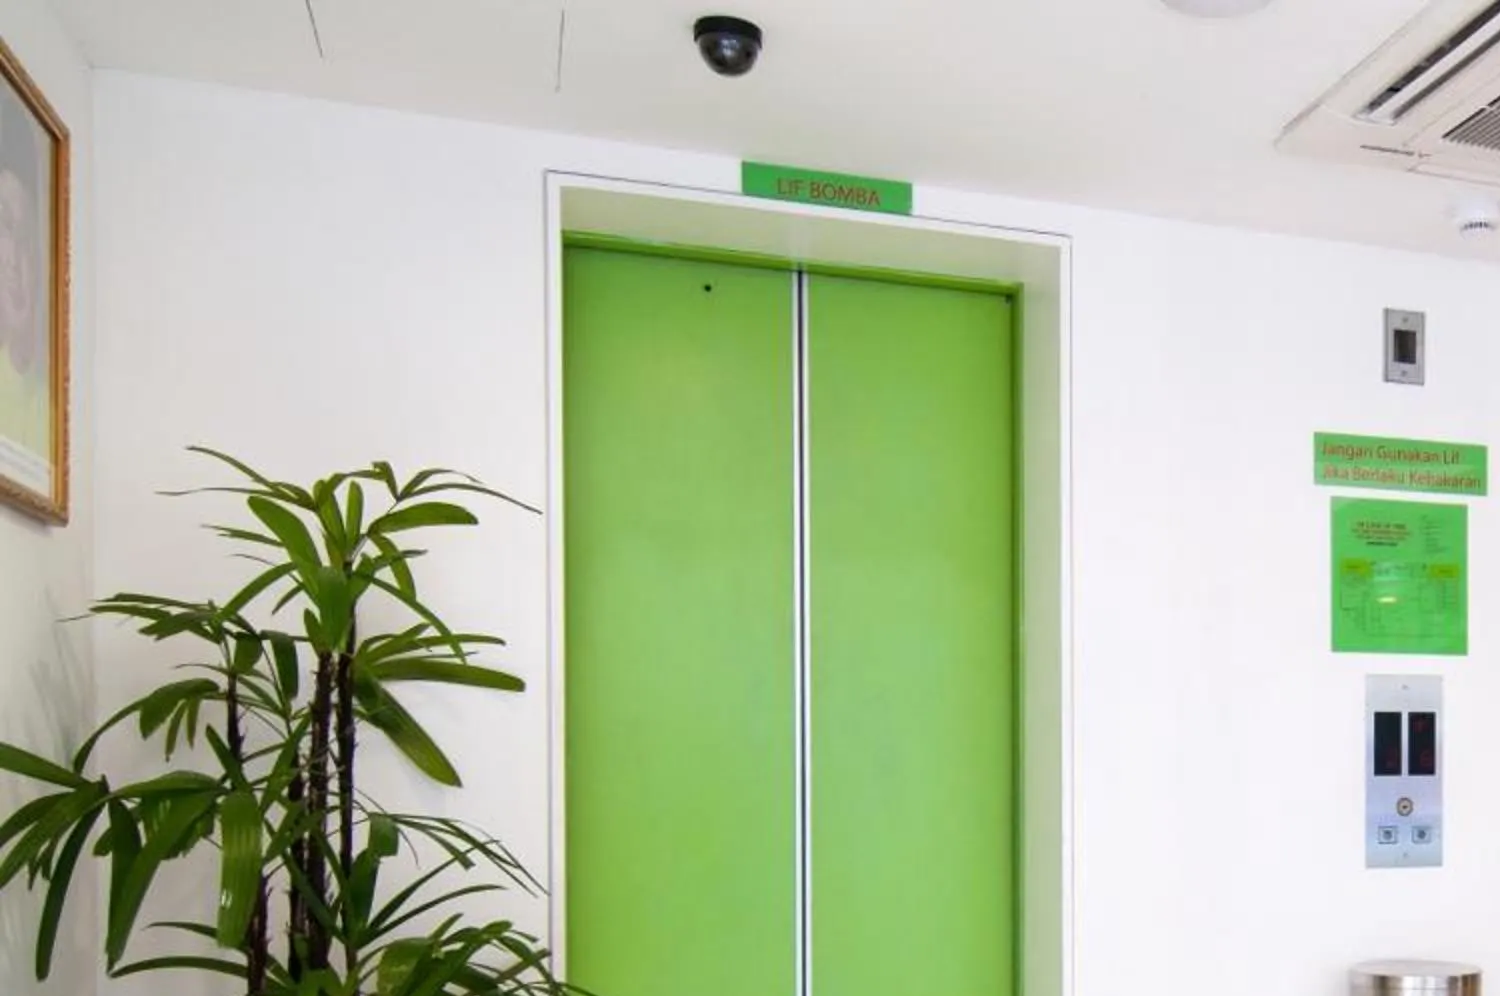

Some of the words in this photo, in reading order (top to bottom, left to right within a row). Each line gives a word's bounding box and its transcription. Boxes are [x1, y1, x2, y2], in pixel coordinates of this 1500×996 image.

[776, 178, 805, 196] LIF
[809, 181, 880, 206] BOMBA
[1322, 442, 1373, 461] Jangan
[1377, 445, 1439, 464] Gunakan
